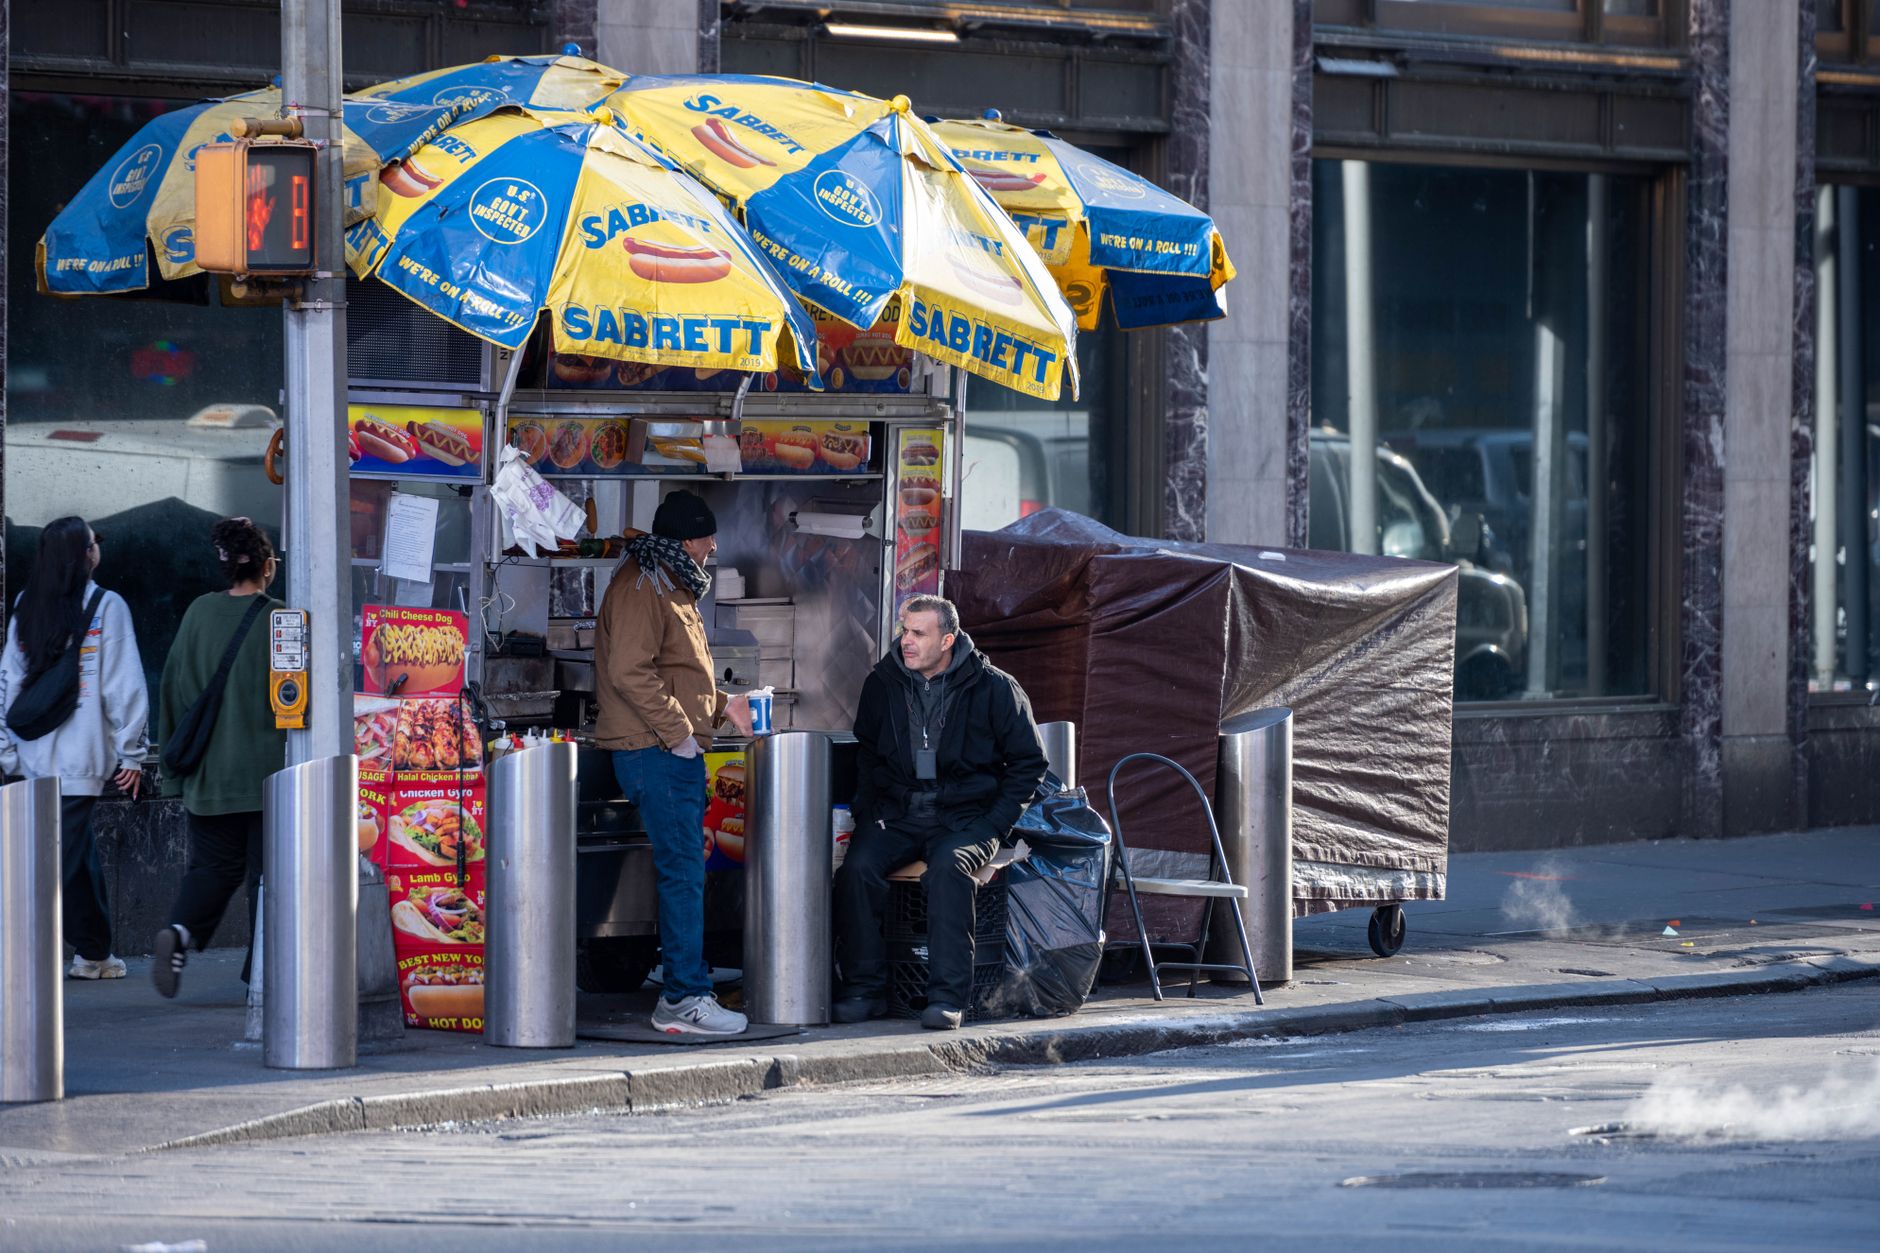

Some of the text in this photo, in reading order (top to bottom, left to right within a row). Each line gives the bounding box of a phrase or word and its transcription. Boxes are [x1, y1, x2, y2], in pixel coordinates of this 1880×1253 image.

[436, 111, 453, 131] ON
[683, 93, 806, 155] SABRETT
[951, 147, 1041, 164] BRETT
[490, 196, 529, 222] GOV'T
[818, 187, 873, 225] INSPECTED
[472, 203, 532, 238] INSPECTED
[578, 202, 712, 250] SABRETT
[1129, 237, 1144, 251] ON
[1145, 240, 1153, 253] A
[1155, 240, 1181, 255] ROLL
[752, 229, 789, 261] WE'RE
[788, 255, 810, 272] ON
[808, 266, 821, 279] A
[820, 270, 854, 297] ROLL
[398, 255, 441, 286] WE'RE
[439, 281, 461, 299] ON
[459, 289, 471, 304] A
[470, 293, 505, 320] ROLL
[560, 303, 771, 356] SABRETT
[909, 297, 1056, 384] SABRETT
[739, 357, 761, 368] 2019
[379, 608, 453, 625] Chili Cheese Dog
[358, 770, 385, 782] USAGE
[397, 772, 419, 782] Halal
[420, 772, 453, 782] Chicken
[359, 787, 387, 806] ORK
[409, 872, 471, 885] Lamb Gyo
[398, 953, 485, 971] BEST NEW YO
[428, 1017, 485, 1030] HOT DO
